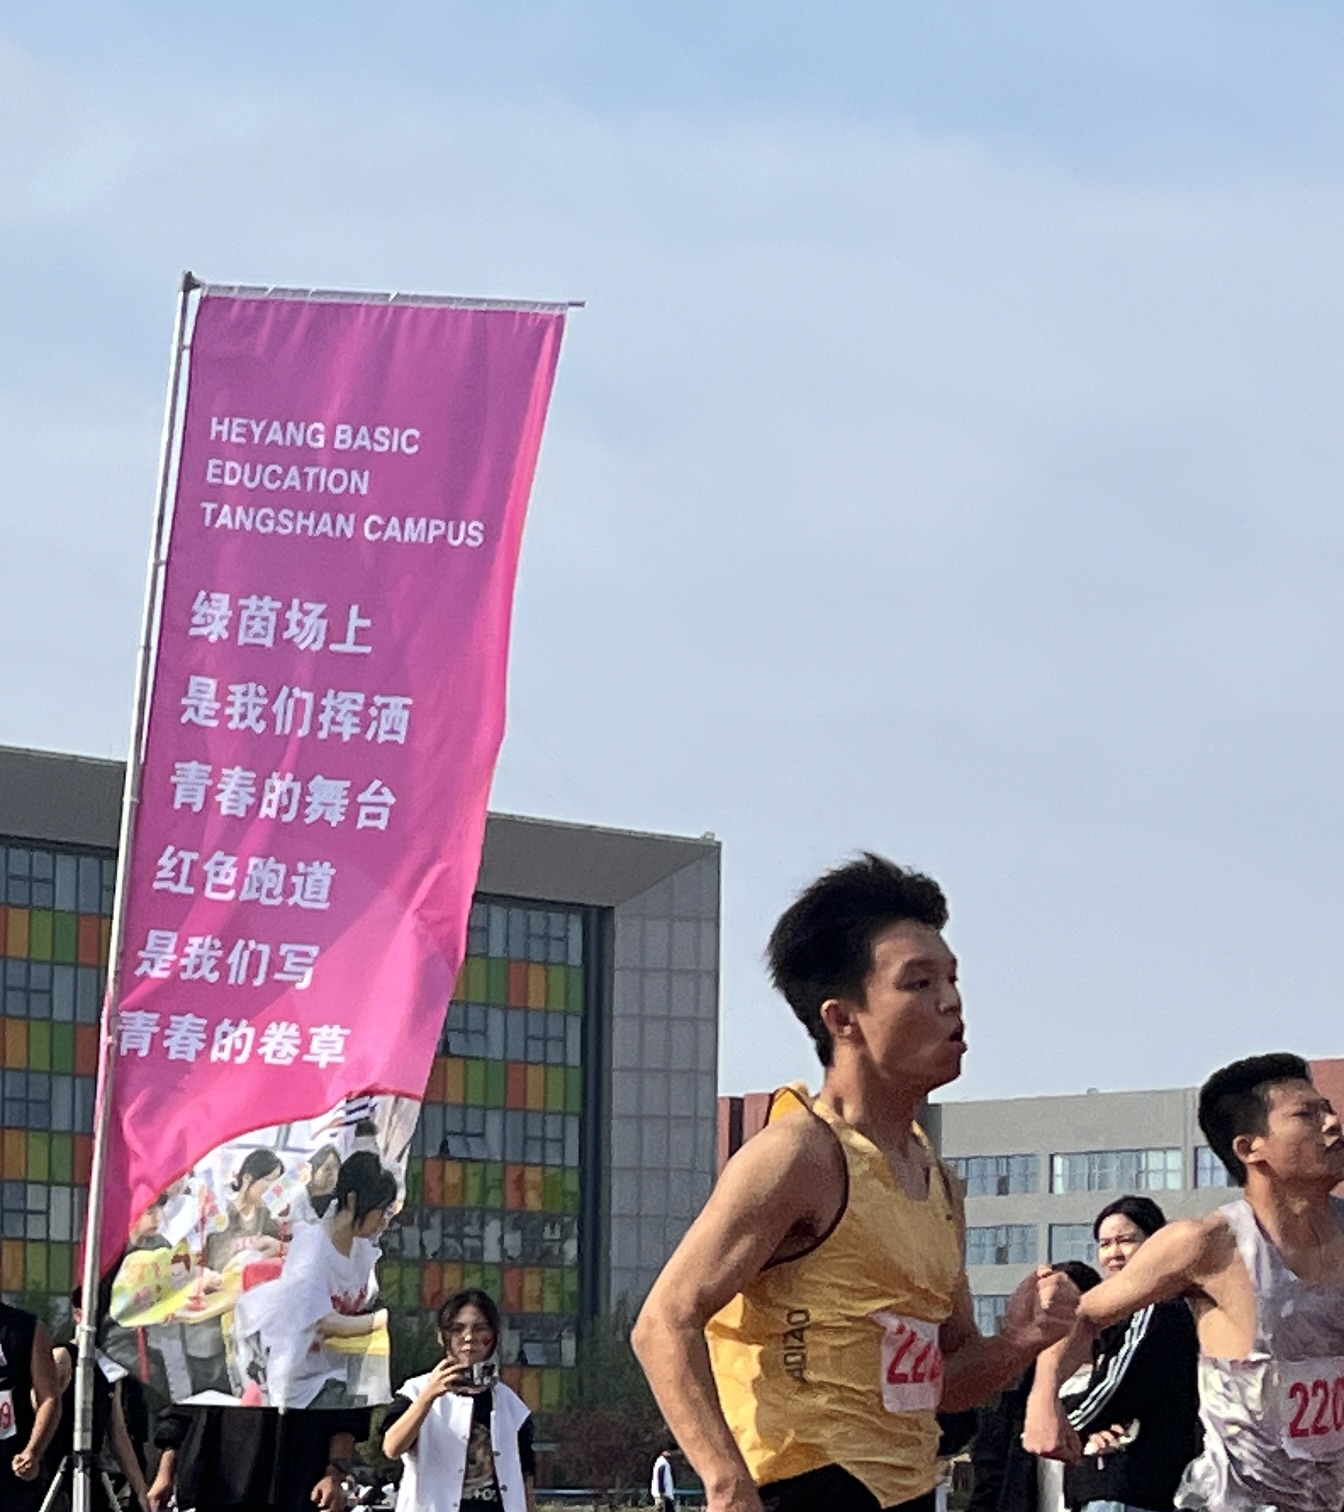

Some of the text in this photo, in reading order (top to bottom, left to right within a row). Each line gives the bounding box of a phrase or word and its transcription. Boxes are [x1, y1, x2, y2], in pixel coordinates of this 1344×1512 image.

[210, 416, 421, 455] HEYANG BASIC
[206, 458, 370, 496] EDUCATION
[200, 501, 485, 547] TANGSHAN CAMPUS
[188, 590, 373, 654] 绿茵场上
[180, 675, 413, 744] 是我们挥洒
[170, 760, 397, 831] 青春的舞台
[152, 845, 337, 910] 红色跑道
[134, 929, 320, 990] 是我们写
